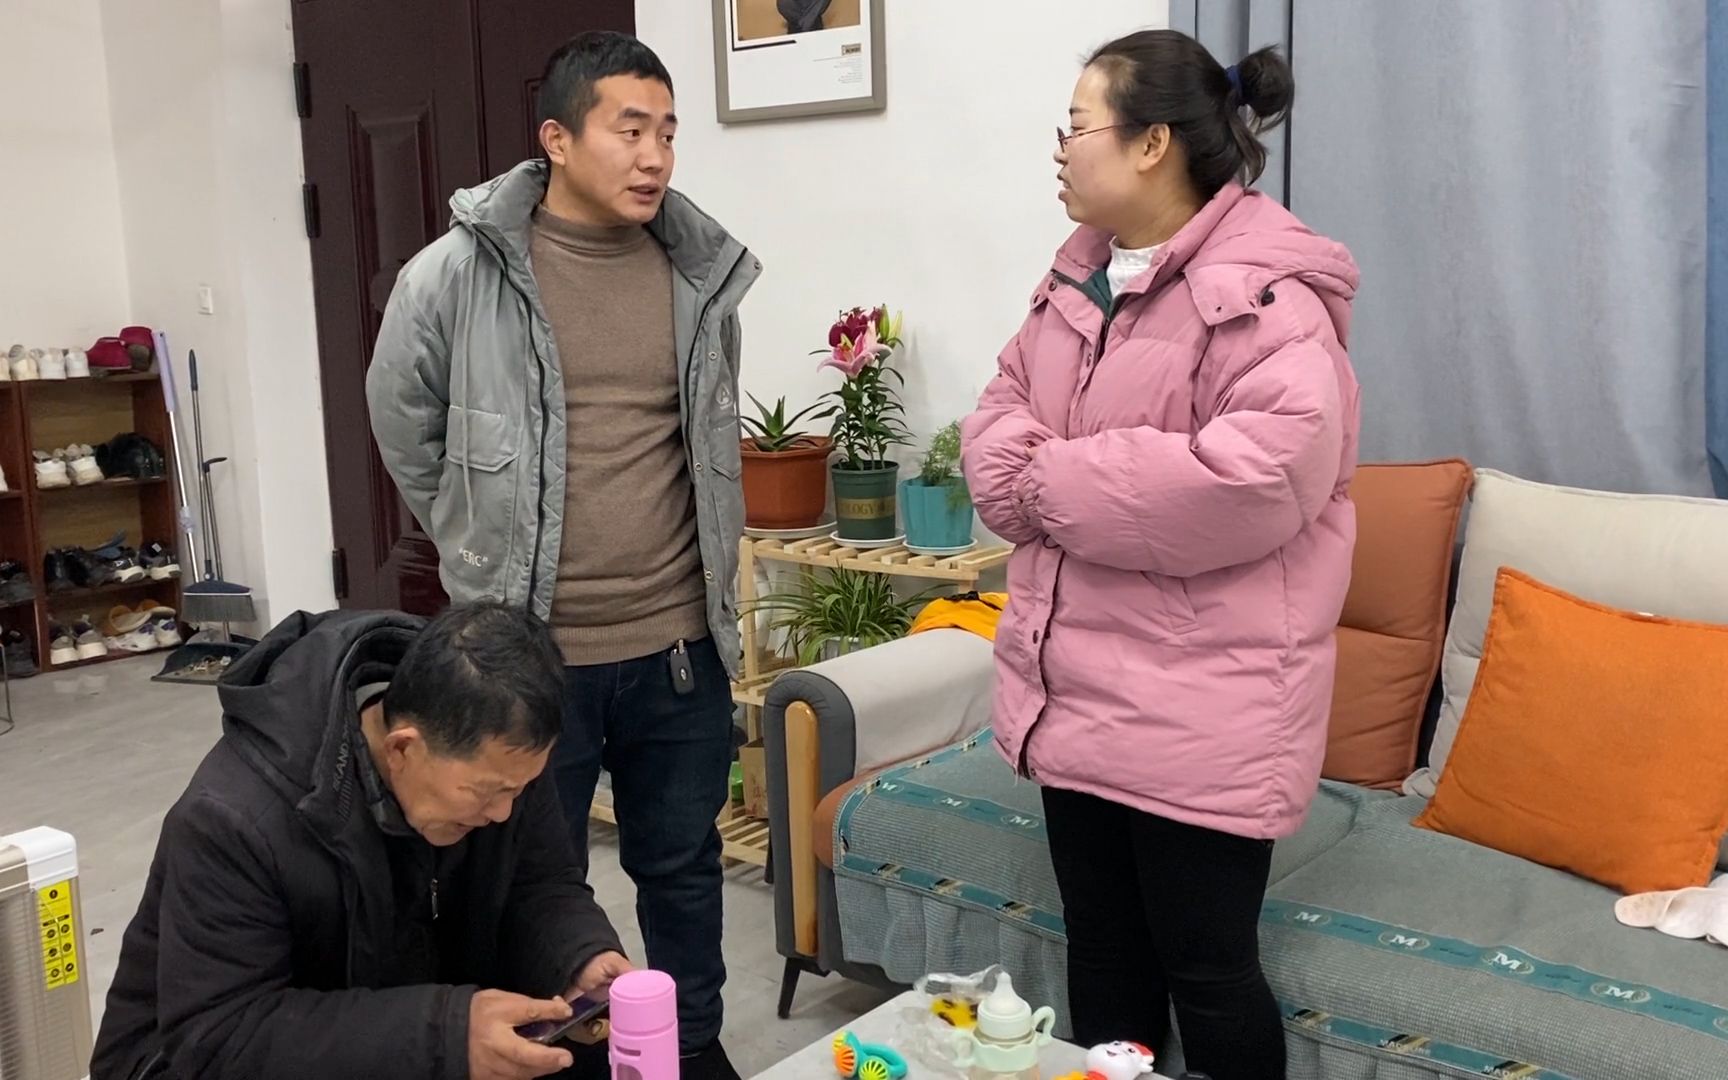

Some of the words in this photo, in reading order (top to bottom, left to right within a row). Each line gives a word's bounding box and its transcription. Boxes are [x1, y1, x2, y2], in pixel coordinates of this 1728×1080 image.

[1293, 911, 1321, 923] M
[1389, 934, 1419, 947] M
[1491, 951, 1522, 970] M
[1605, 986, 1635, 999] M
